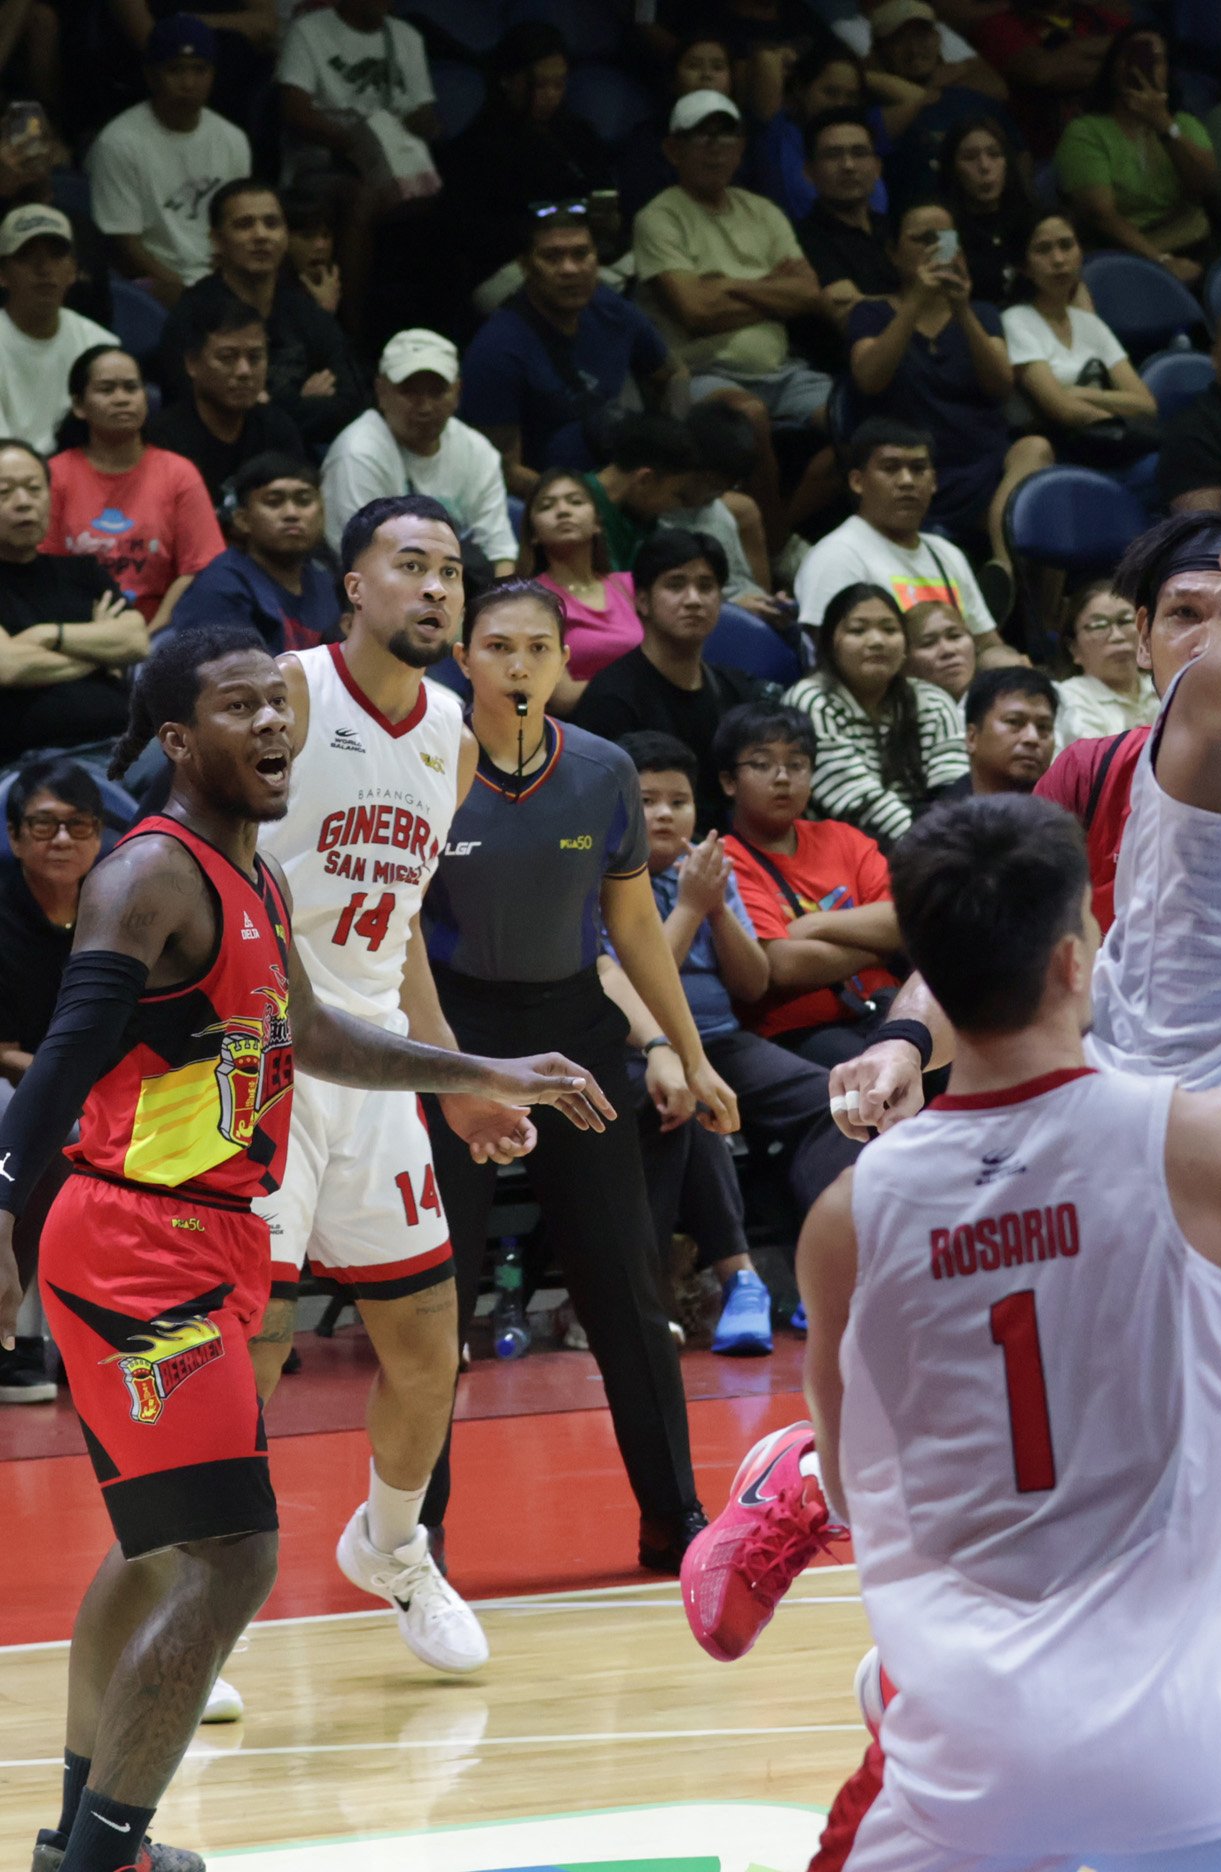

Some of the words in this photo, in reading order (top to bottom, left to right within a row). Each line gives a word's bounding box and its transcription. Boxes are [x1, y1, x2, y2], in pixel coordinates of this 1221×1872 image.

[323, 850, 367, 882] SAN
[241, 928, 260, 941] DELTA
[331, 892, 396, 952] 14
[394, 1163, 442, 1227] 14
[930, 1202, 1080, 1280] ROSARIO
[990, 1288, 1056, 1494] 1
